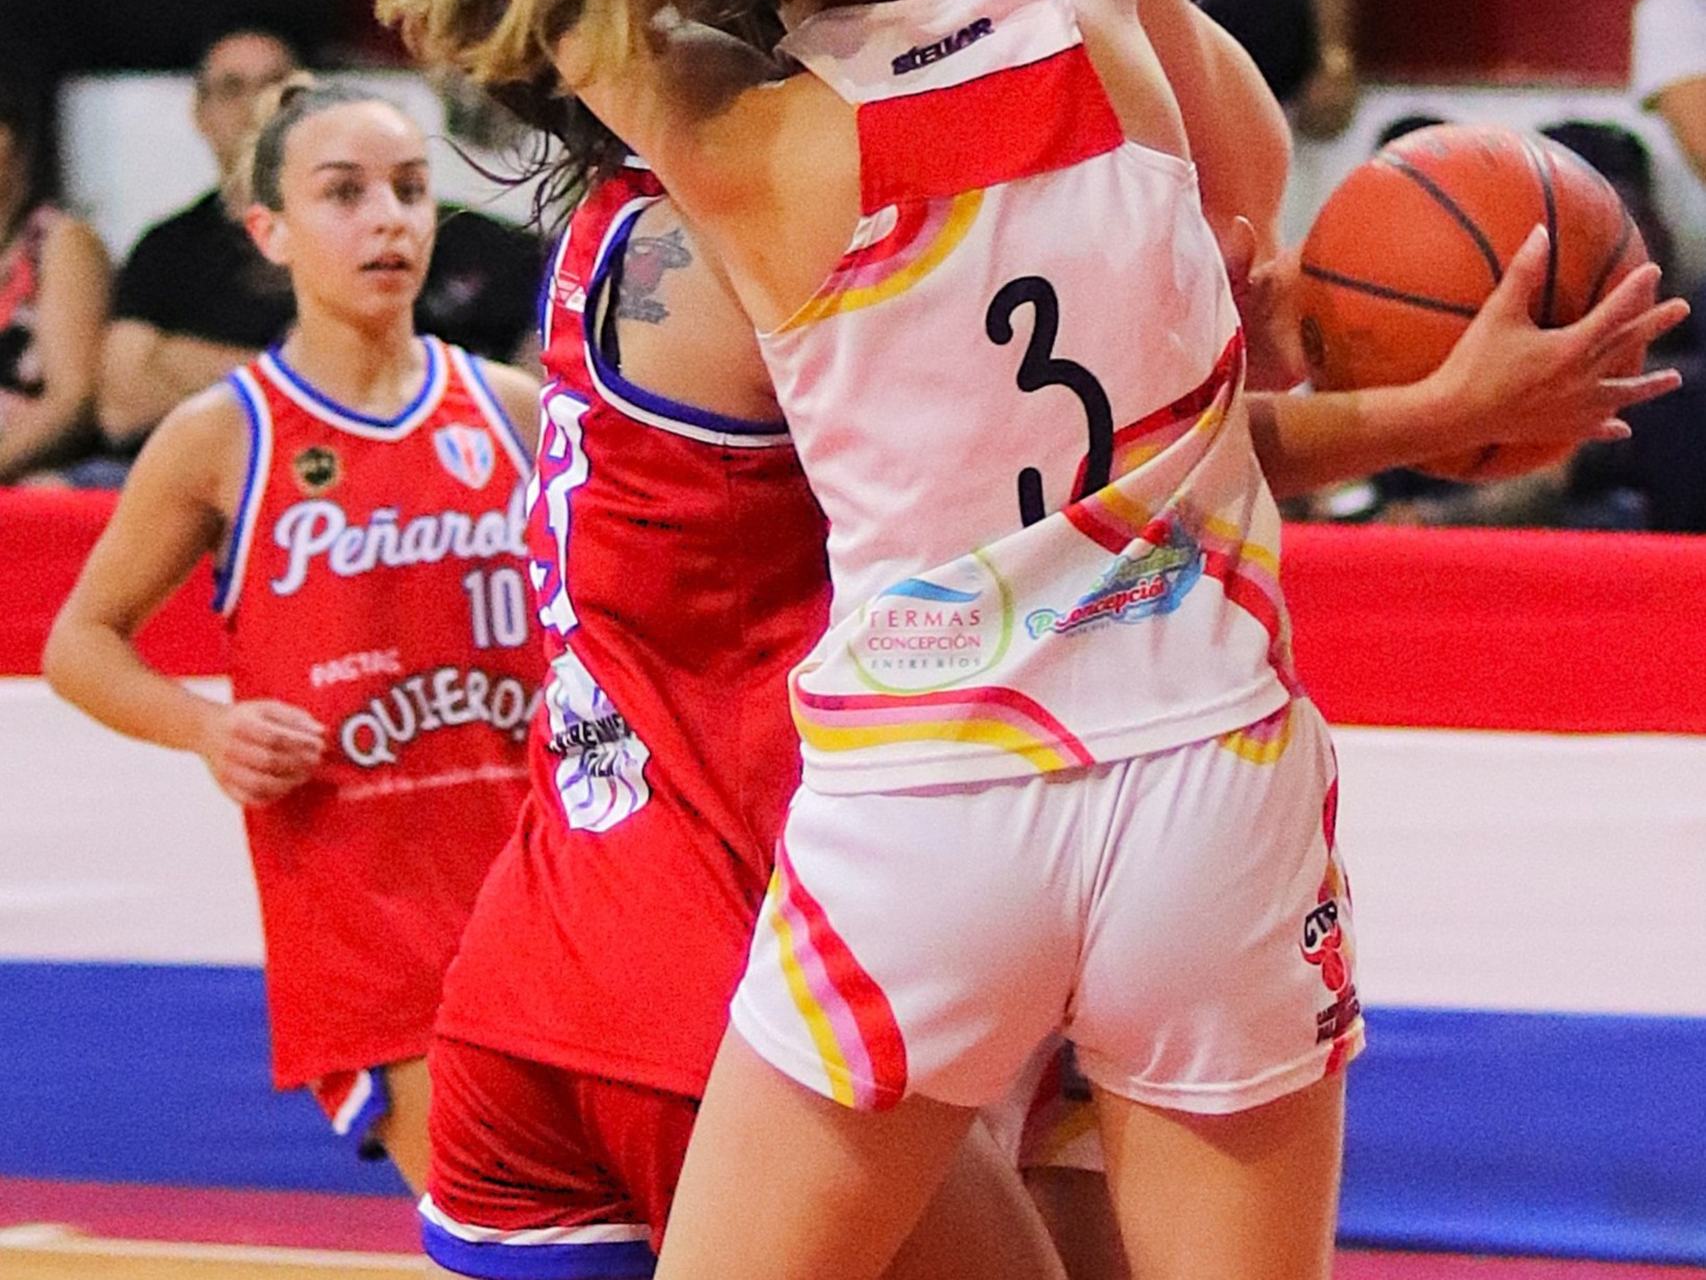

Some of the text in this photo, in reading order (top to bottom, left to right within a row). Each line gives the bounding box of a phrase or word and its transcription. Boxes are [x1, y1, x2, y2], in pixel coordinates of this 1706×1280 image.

[984, 275, 1113, 527] 3
[271, 481, 528, 596] Peñarol
[463, 568, 527, 649] 10
[868, 632, 981, 651] CONCEPCIÓN
[870, 609, 981, 628] TERMAS
